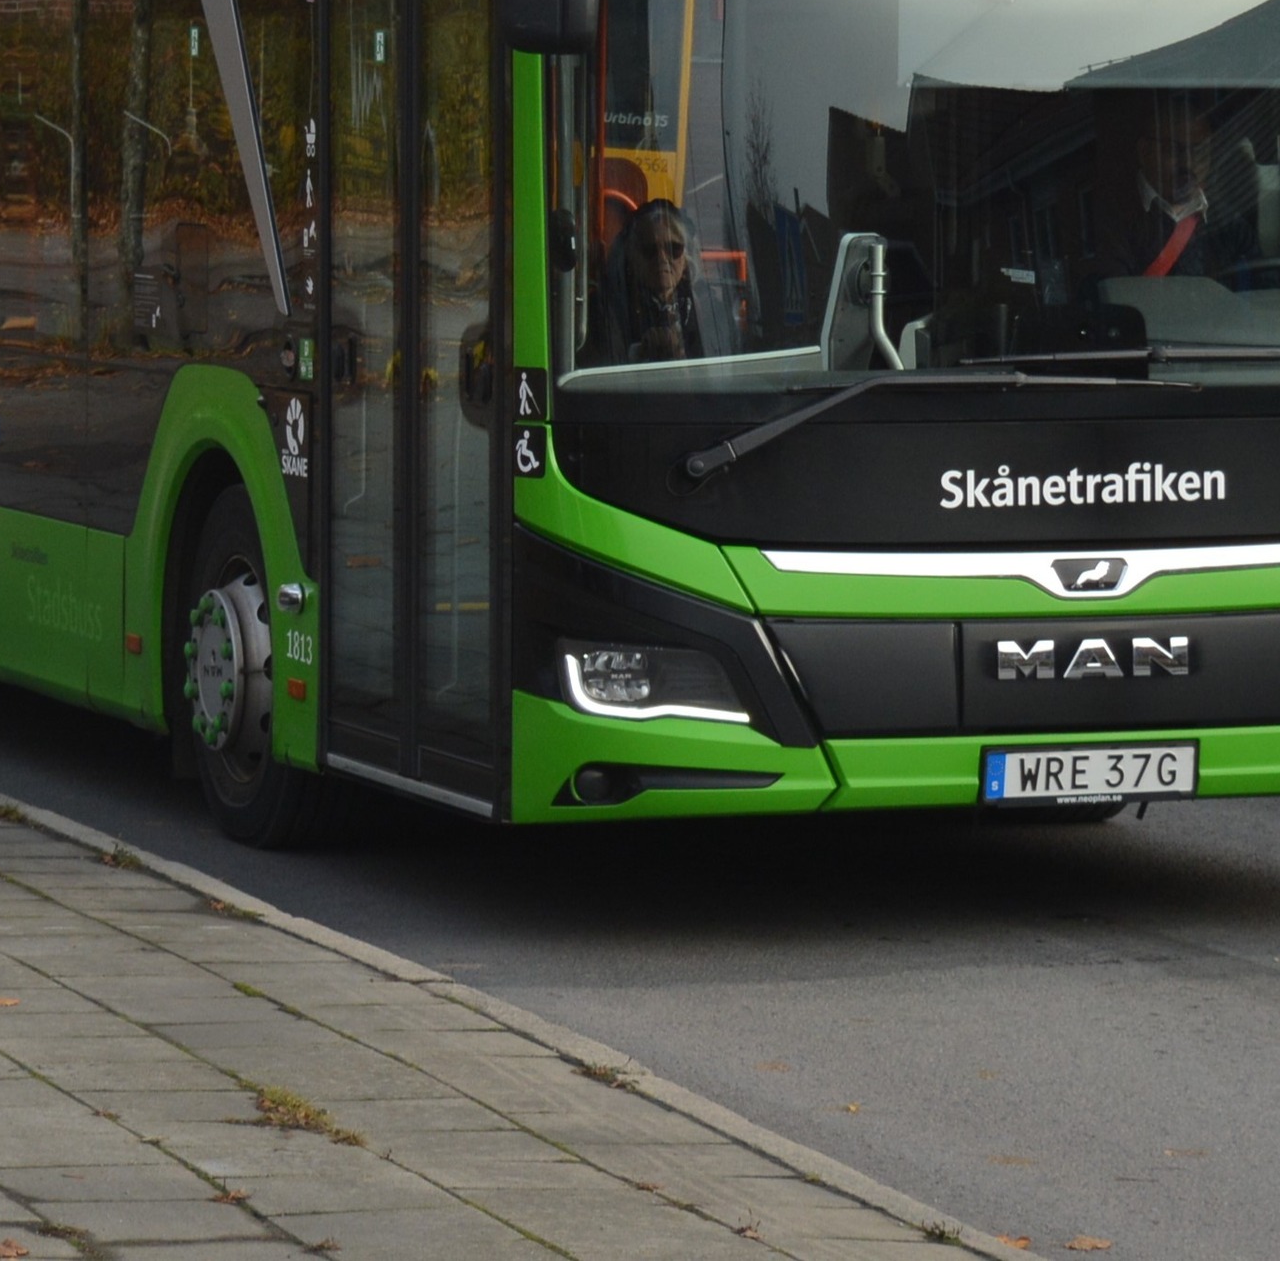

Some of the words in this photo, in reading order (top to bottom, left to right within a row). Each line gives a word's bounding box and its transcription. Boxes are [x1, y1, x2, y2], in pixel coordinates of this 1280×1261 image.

[939, 462, 1226, 509] Skånetrafiken
[27, 575, 103, 642] Stadsbuss
[286, 629, 313, 665] 1813
[997, 636, 1189, 680] MAN
[991, 781, 999, 790] S
[1019, 755, 1090, 792] WRE
[1105, 753, 1177, 788] 37G
[1056, 792, 1123, 804] www.neoplan.se
